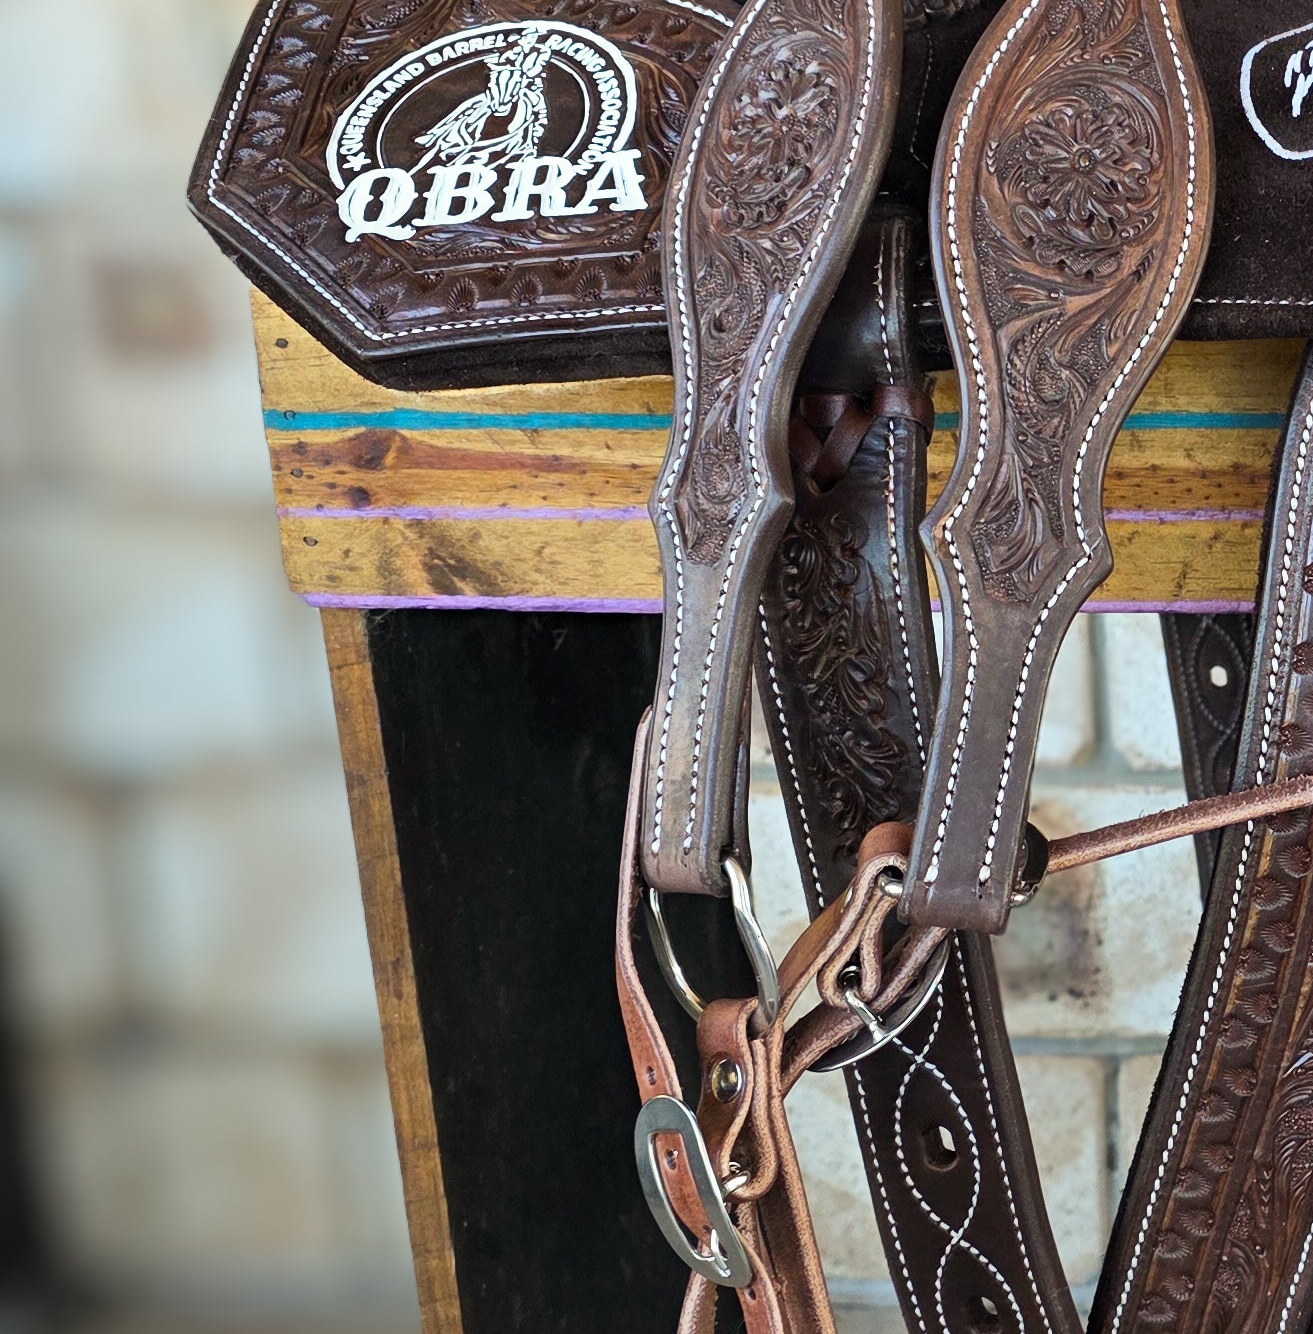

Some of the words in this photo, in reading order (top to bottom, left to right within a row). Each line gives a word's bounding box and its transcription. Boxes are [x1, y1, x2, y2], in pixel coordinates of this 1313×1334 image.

[425, 33, 507, 67] BARREL
[545, 34, 606, 73] RACING
[340, 62, 425, 155] QUEENSLAND
[573, 69, 622, 175] ASSOCIATION
[335, 148, 650, 243] QBRA
